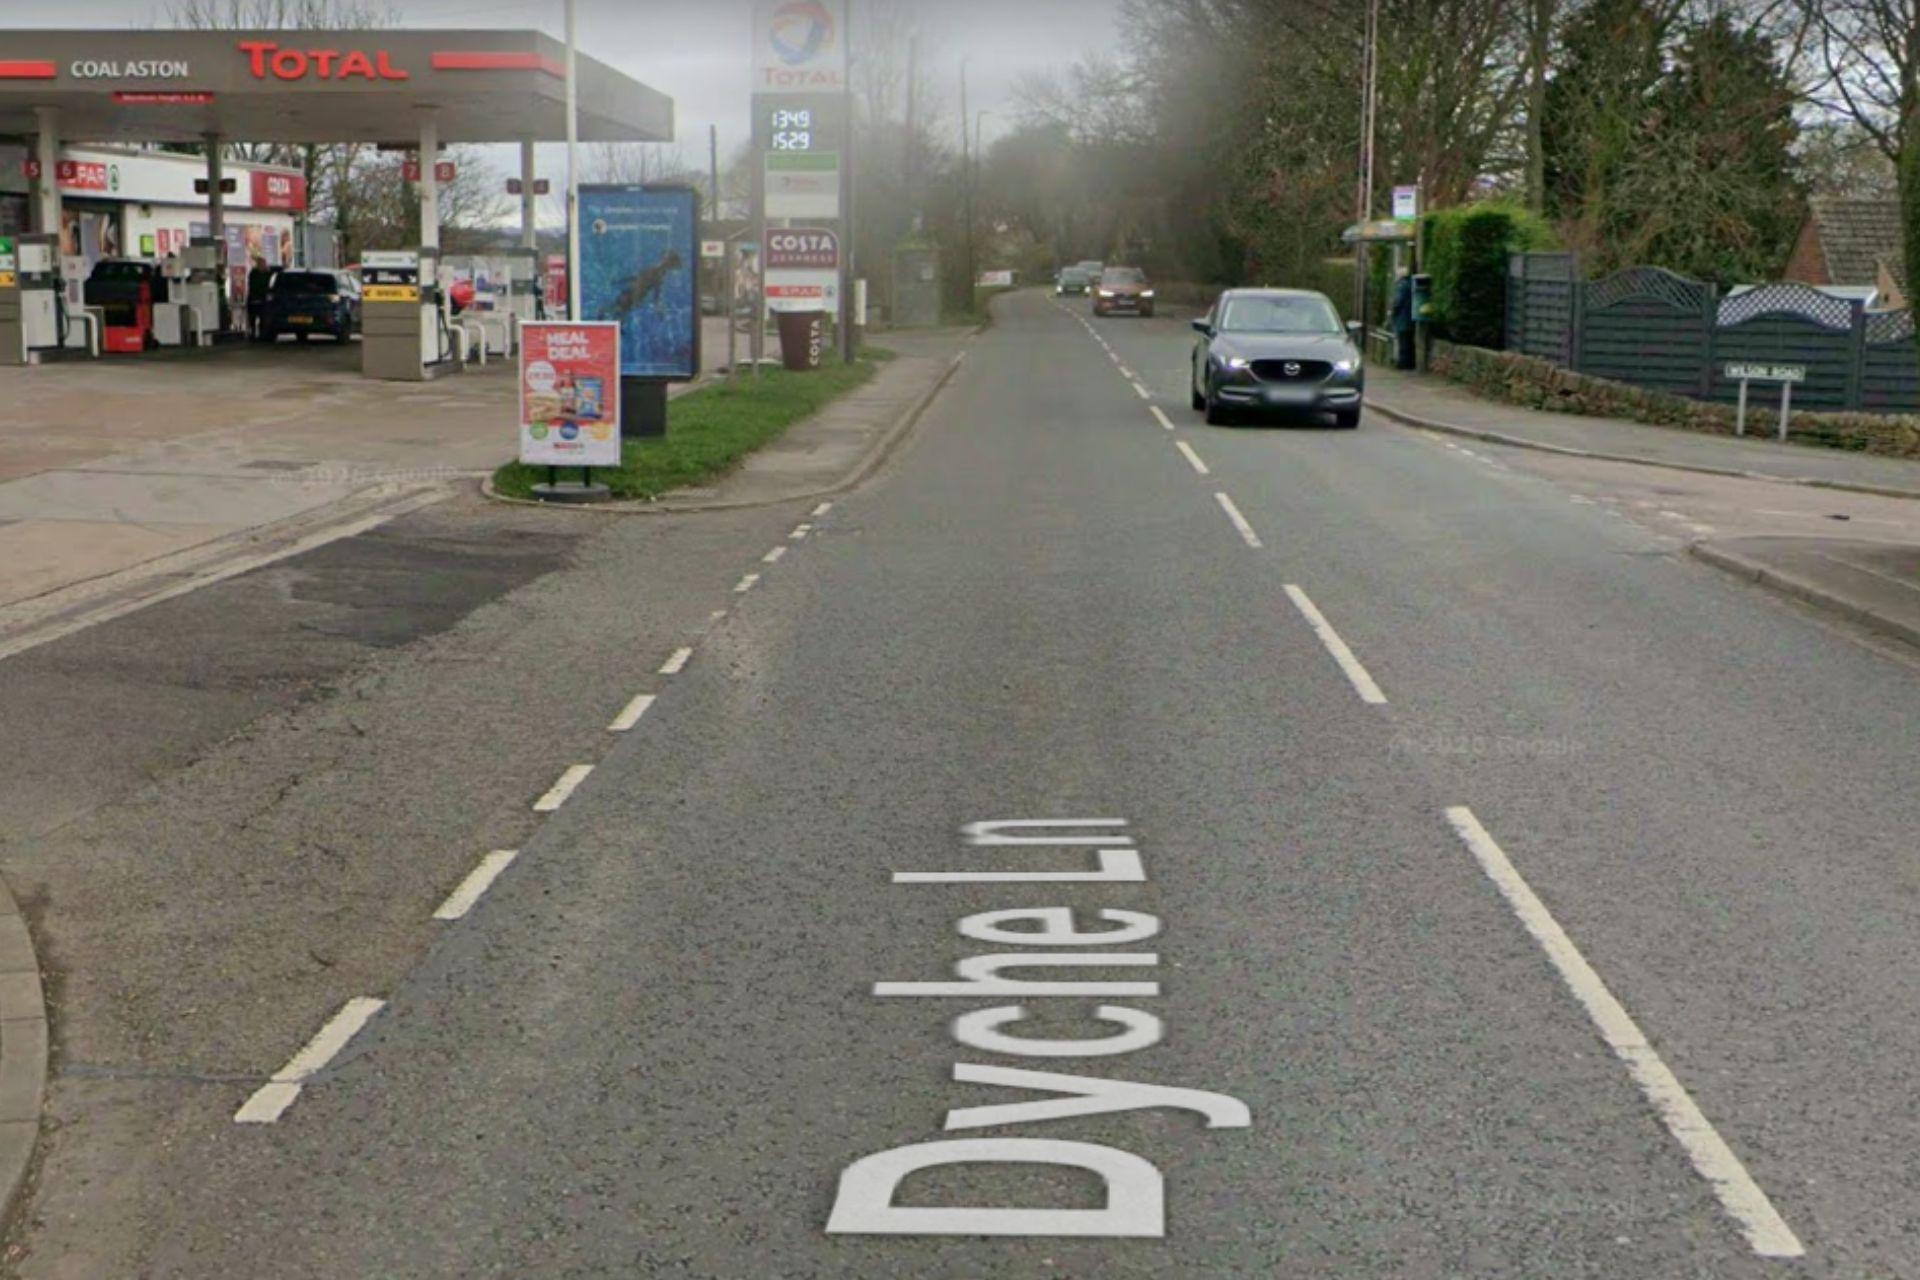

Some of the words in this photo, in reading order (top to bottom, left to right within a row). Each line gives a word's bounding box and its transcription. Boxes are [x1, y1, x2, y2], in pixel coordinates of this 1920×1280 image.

[71, 60, 119, 78] COAL
[124, 60, 188, 78] ASTON
[237, 40, 409, 81] TOTAL
[761, 67, 841, 87] TOTAL
[770, 235, 833, 252] COSTA
[546, 331, 590, 346] MEAL
[808, 320, 821, 366] COSTA
[548, 345, 592, 360] DEAL
